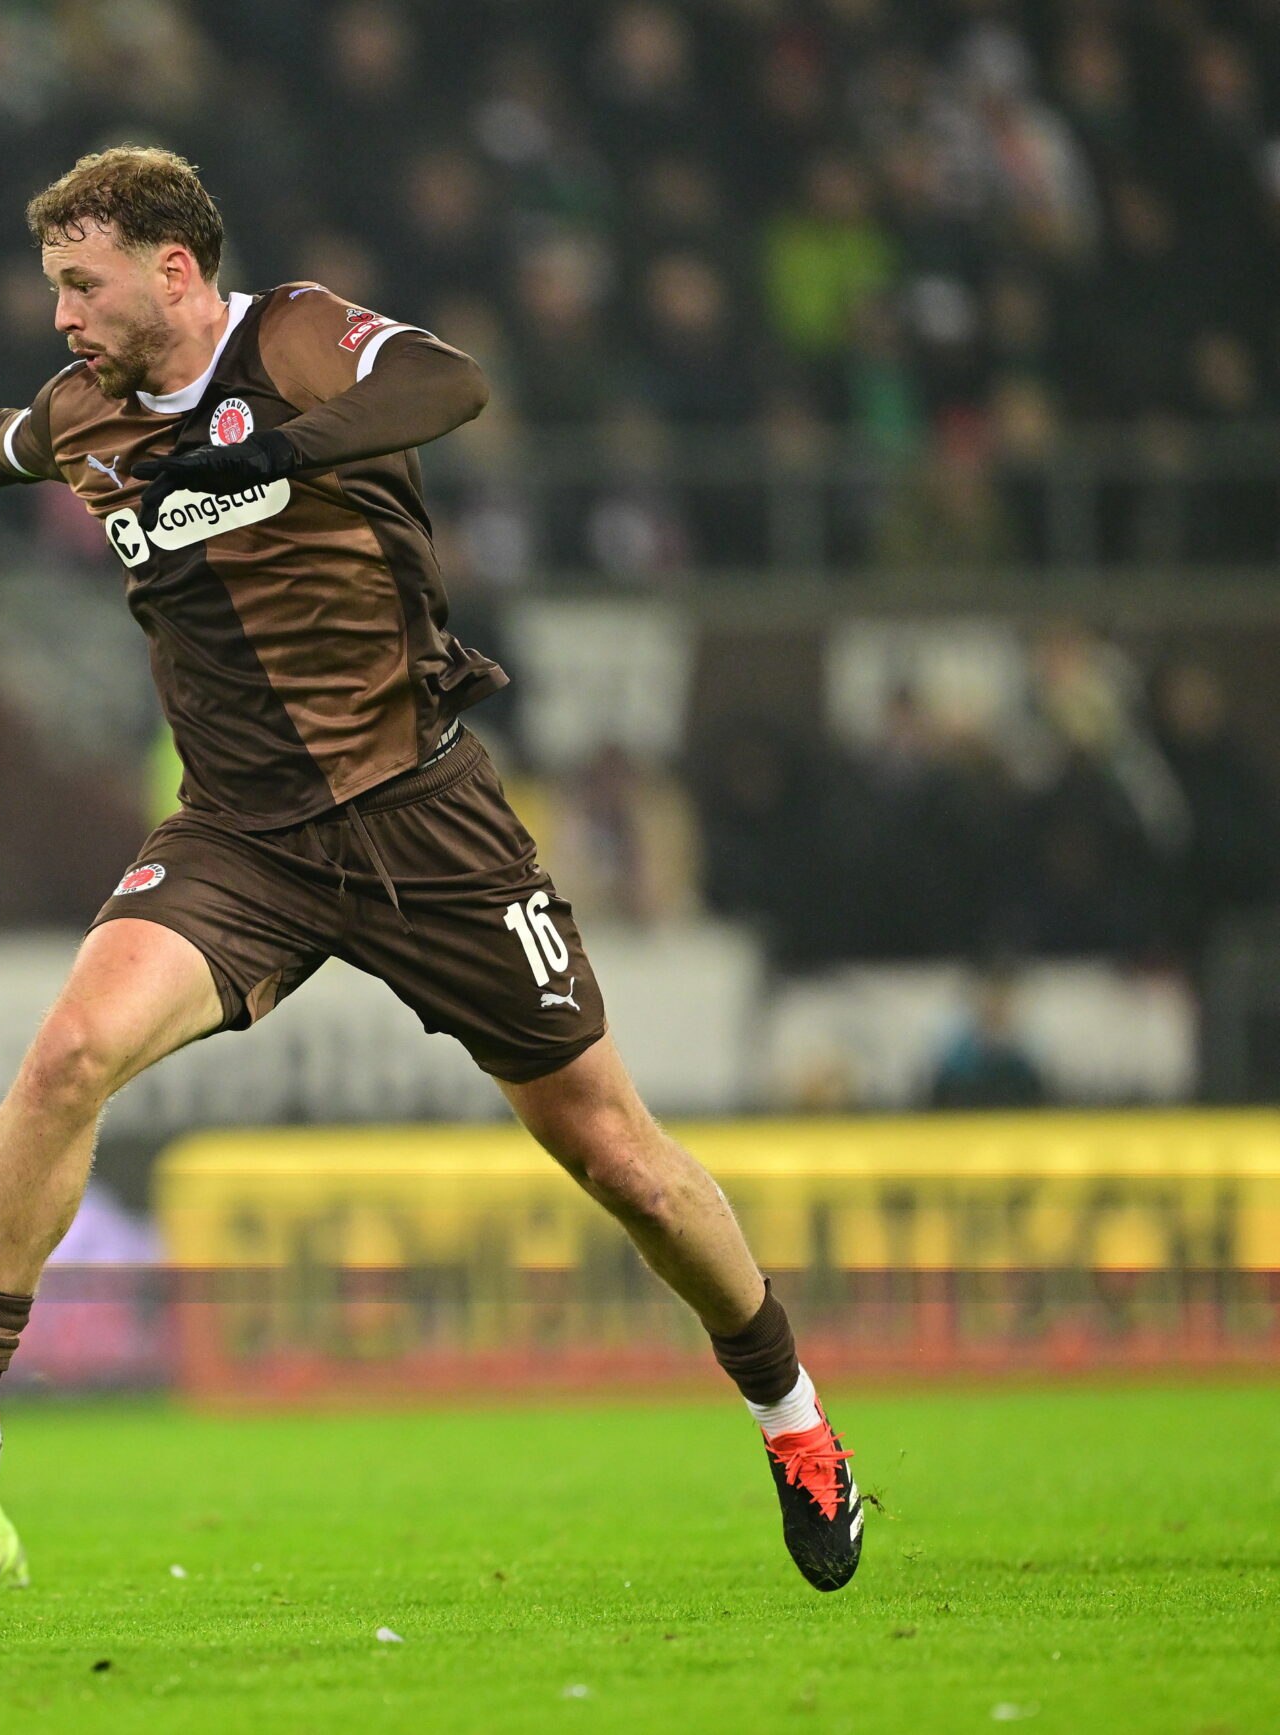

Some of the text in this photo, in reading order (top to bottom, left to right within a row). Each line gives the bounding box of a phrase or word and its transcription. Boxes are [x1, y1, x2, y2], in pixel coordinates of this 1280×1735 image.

[225, 399, 249, 417] PAULI
[159, 483, 270, 531] congstar
[503, 890, 569, 988] 16
